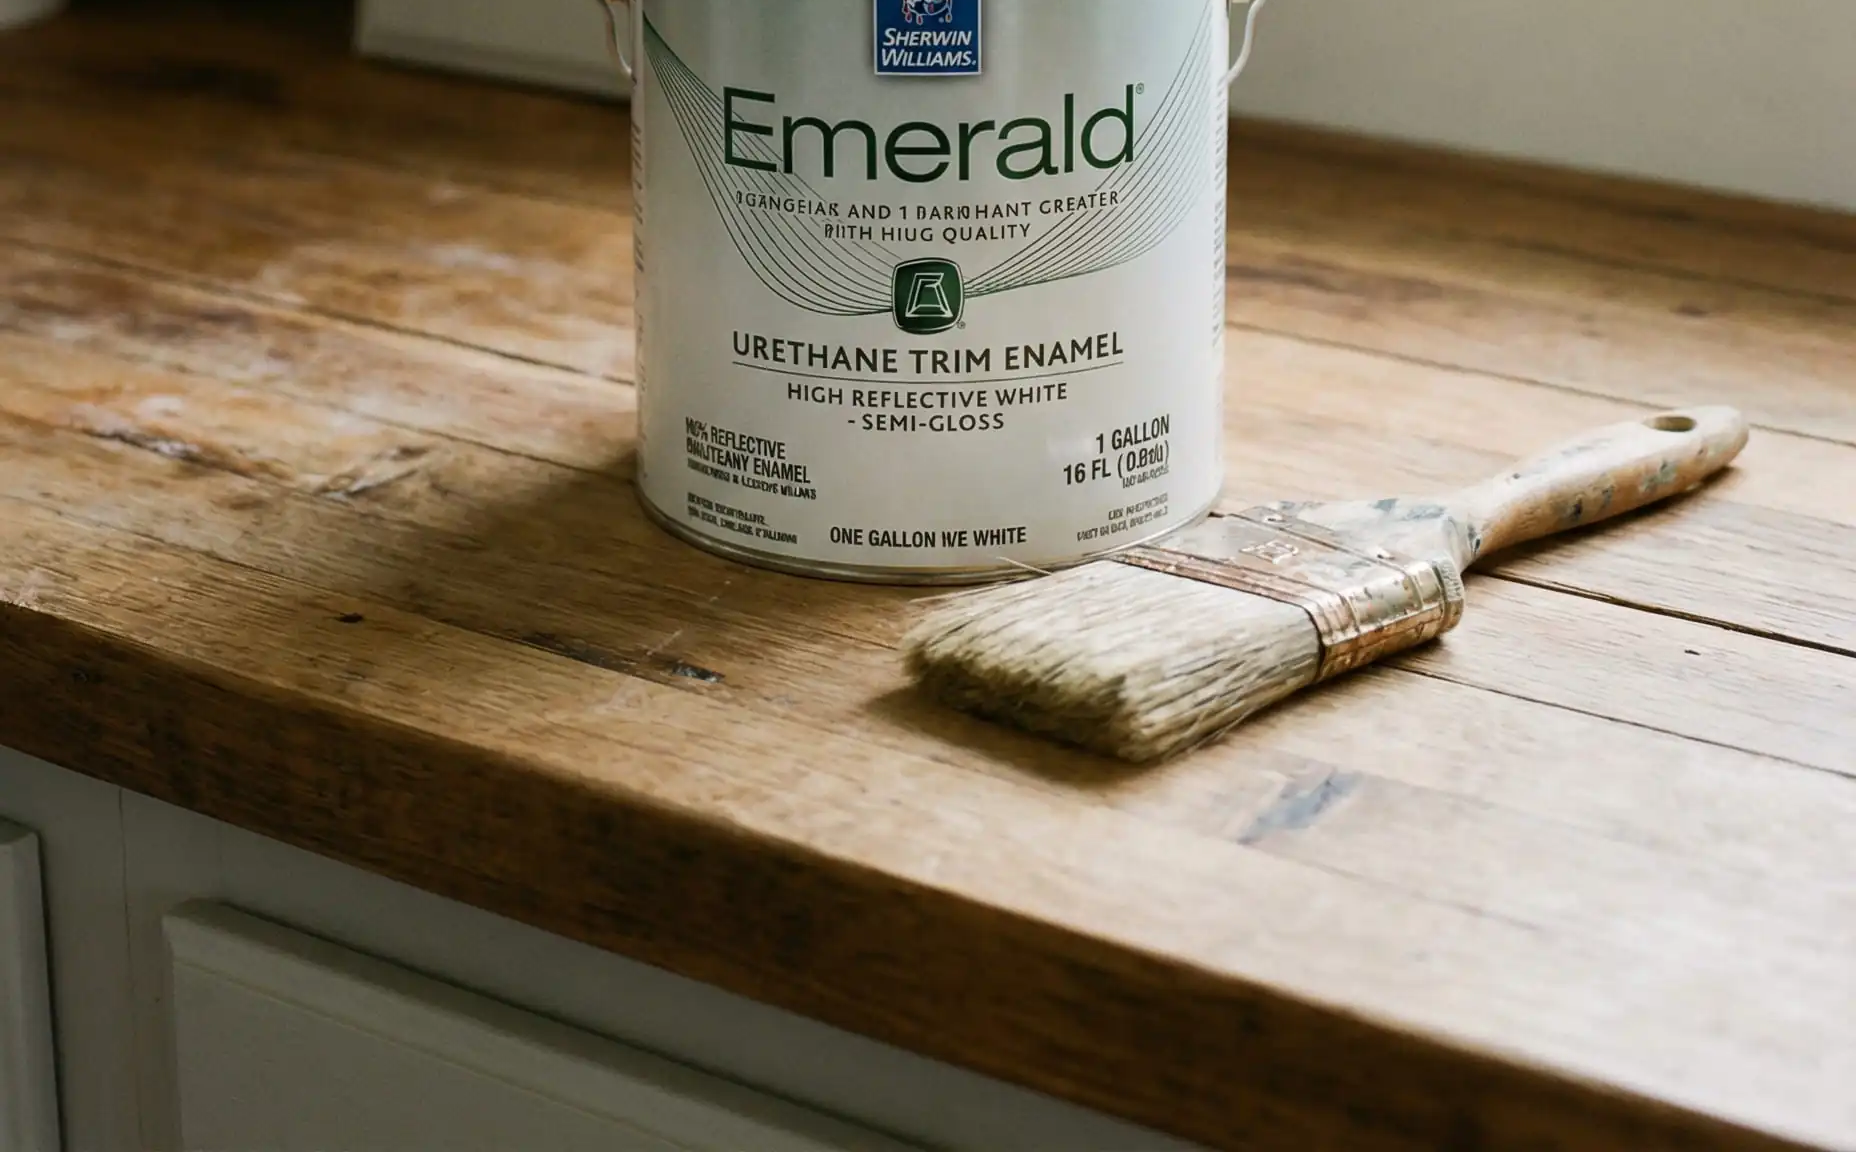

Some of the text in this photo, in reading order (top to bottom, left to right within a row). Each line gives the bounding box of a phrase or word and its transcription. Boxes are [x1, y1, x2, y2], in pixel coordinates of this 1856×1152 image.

[882, 27, 973, 47] SHERWIN
[848, 204, 891, 220] AND
[1039, 191, 1119, 215] GREATER
[882, 227, 933, 242] HIUG
[942, 223, 1031, 244] QUALITY
[733, 331, 1124, 374] URETHANE TRIM ENAMEL
[787, 383, 1068, 408] HIGH REFLECTIVE WHITE
[861, 412, 1005, 432] SEMI-GLOSS
[1096, 414, 1170, 454] 1 GALLON
[710, 426, 786, 460] REFLECTIVE
[753, 458, 811, 483] ENAMEL
[1063, 463, 1086, 485] 16
[1092, 458, 1112, 480] FL
[830, 526, 863, 546] ONE
[868, 530, 935, 548] GALLON
[973, 526, 1027, 547] WHITE
